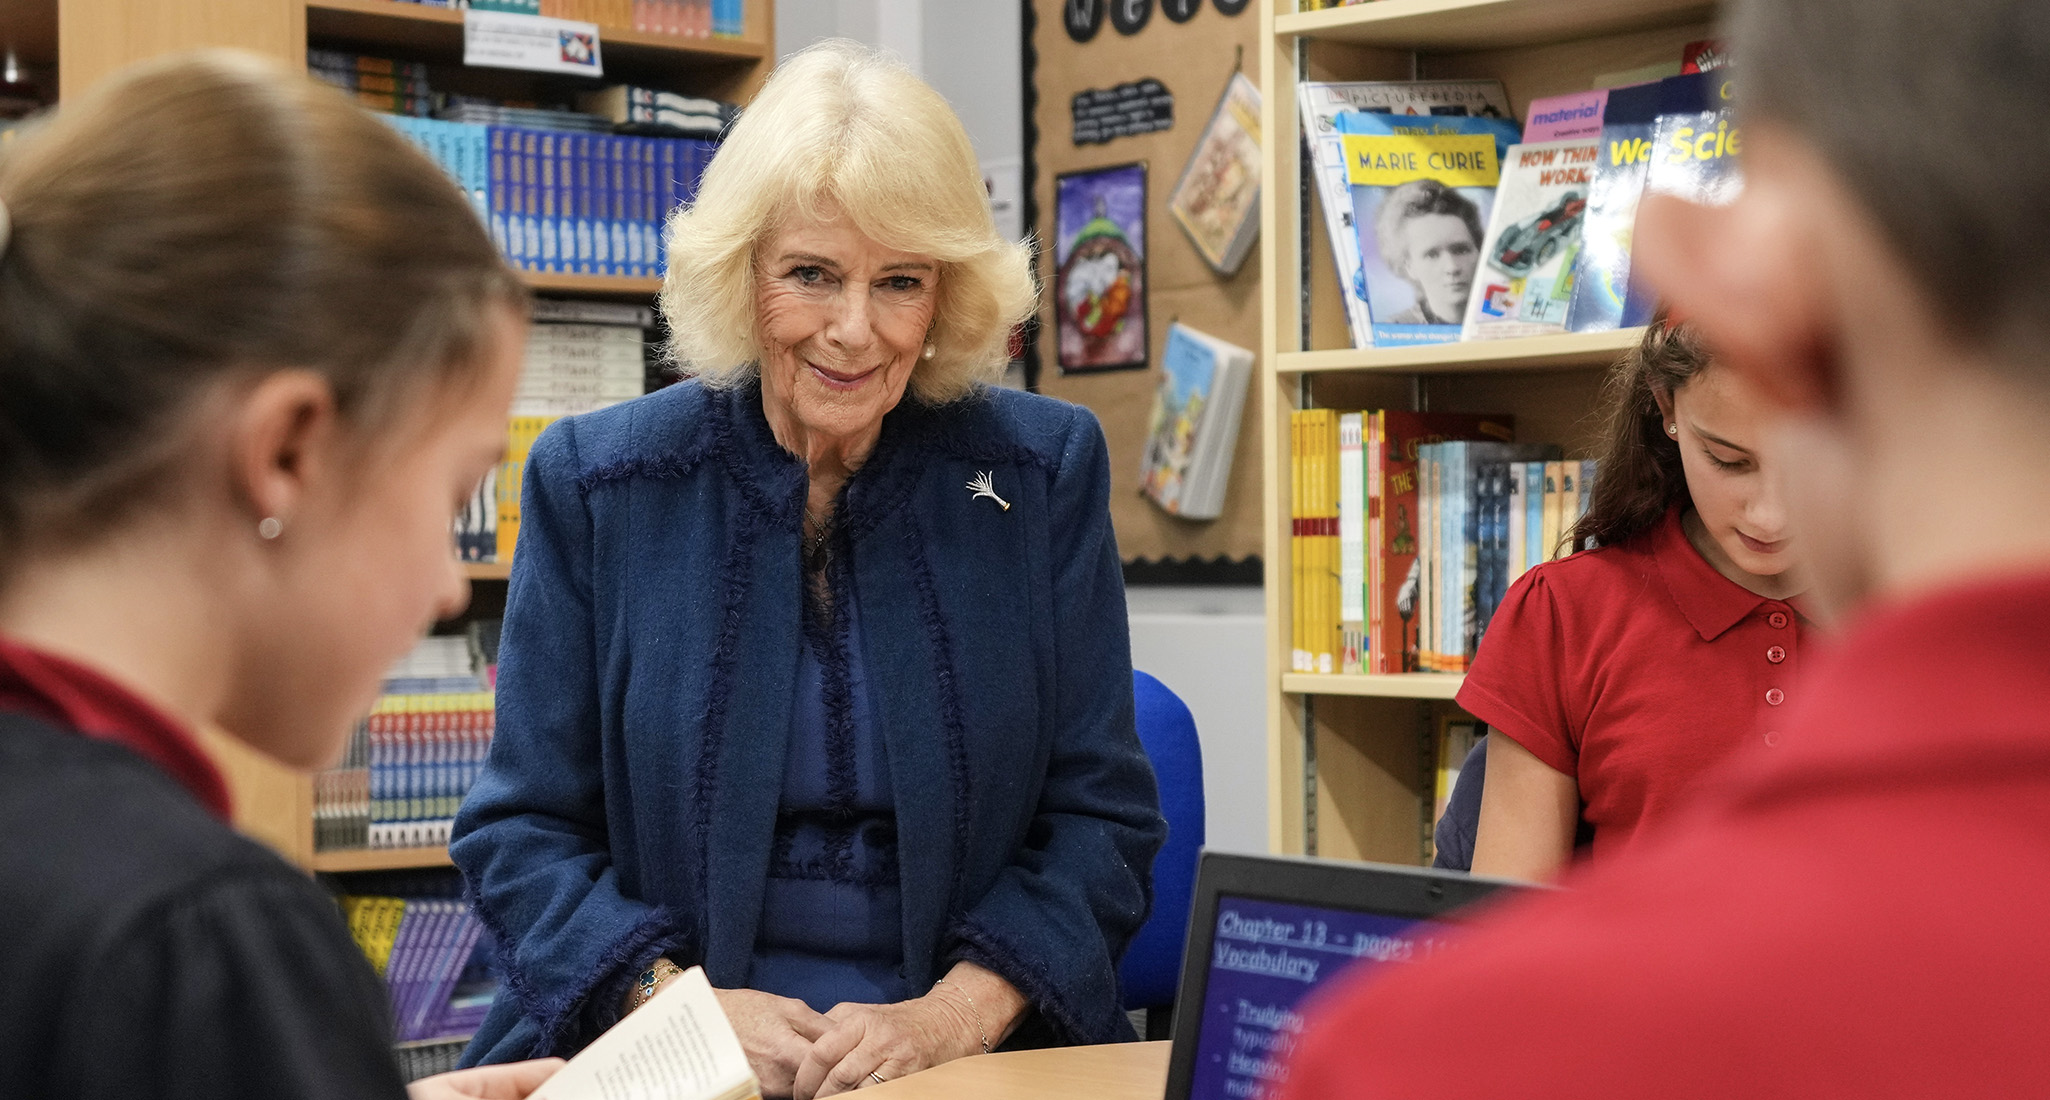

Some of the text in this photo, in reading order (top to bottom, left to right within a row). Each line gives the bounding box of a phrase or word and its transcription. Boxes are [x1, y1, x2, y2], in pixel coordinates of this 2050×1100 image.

[1351, 91, 1487, 104] PICTUREPEDIA
[1533, 99, 1599, 125] material
[1701, 109, 1717, 125] My
[1358, 151, 1486, 171] MARIE CURIE
[1519, 150, 1554, 168] HOW
[1390, 469, 1413, 496] THE
[1218, 909, 1295, 943] Chapter
[1301, 918, 1329, 948] 13
[1352, 931, 1415, 962] pages
[1214, 939, 1320, 984] Vocabulary
[1237, 998, 1304, 1034] Trudging
[1233, 1026, 1298, 1059] typically
